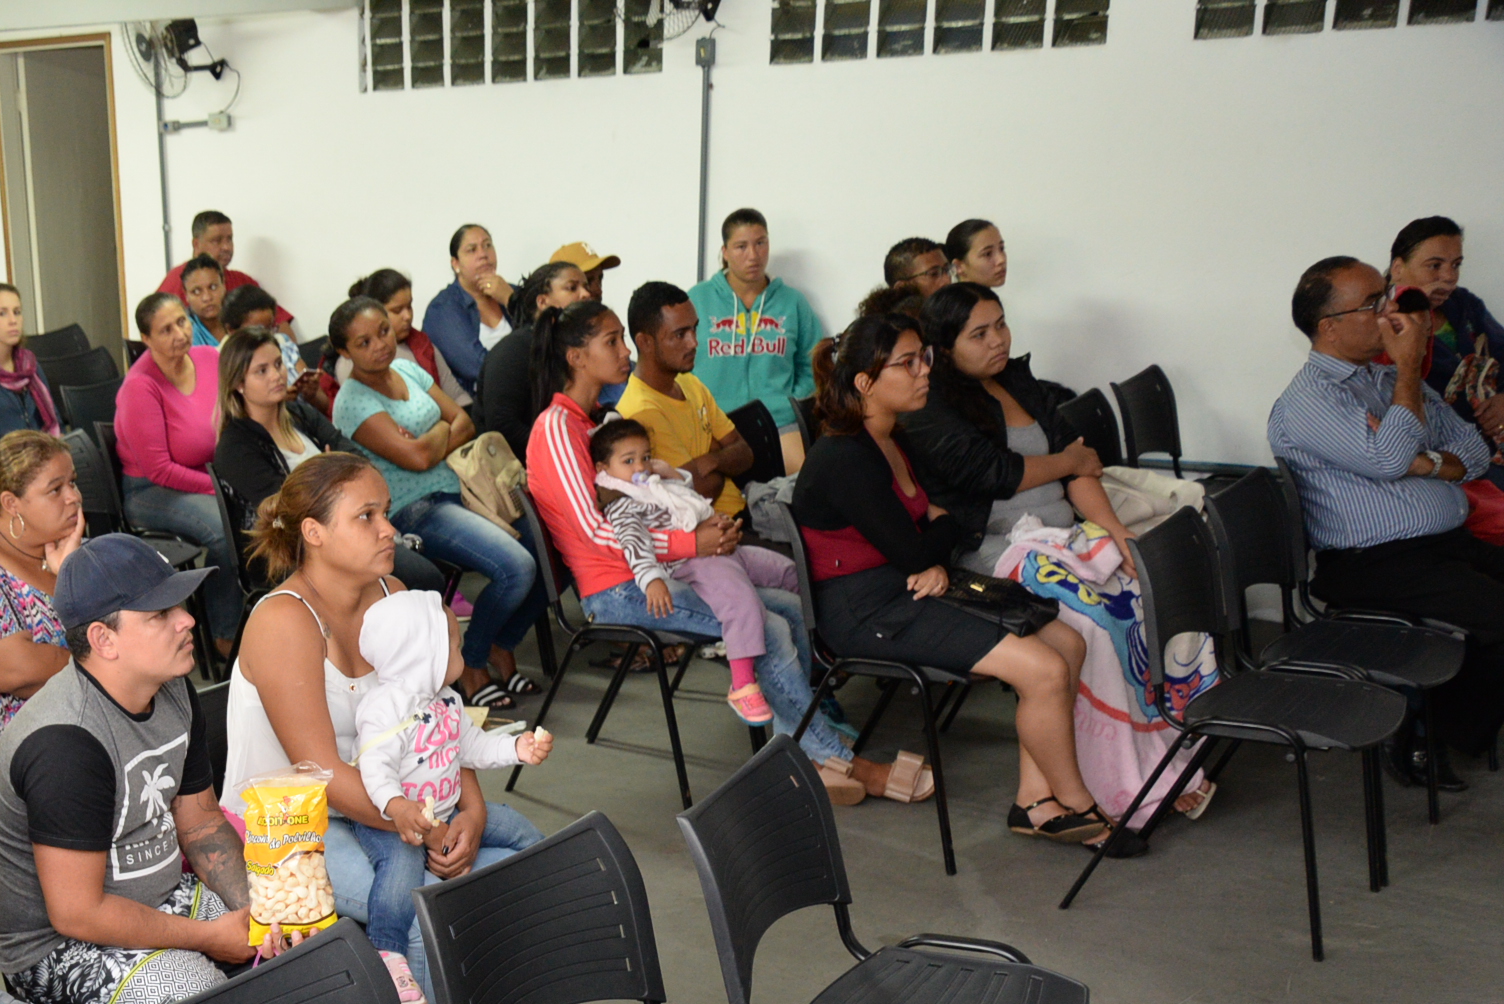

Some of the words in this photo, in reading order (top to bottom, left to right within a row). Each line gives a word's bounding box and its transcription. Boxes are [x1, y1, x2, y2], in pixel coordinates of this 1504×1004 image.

[708, 337, 746, 357] Red
[751, 335, 787, 357] Bull
[413, 708, 461, 753] LOO
[282, 831, 321, 846] Polvilho
[125, 840, 169, 866] SINCE
[246, 860, 275, 876] Salgado
